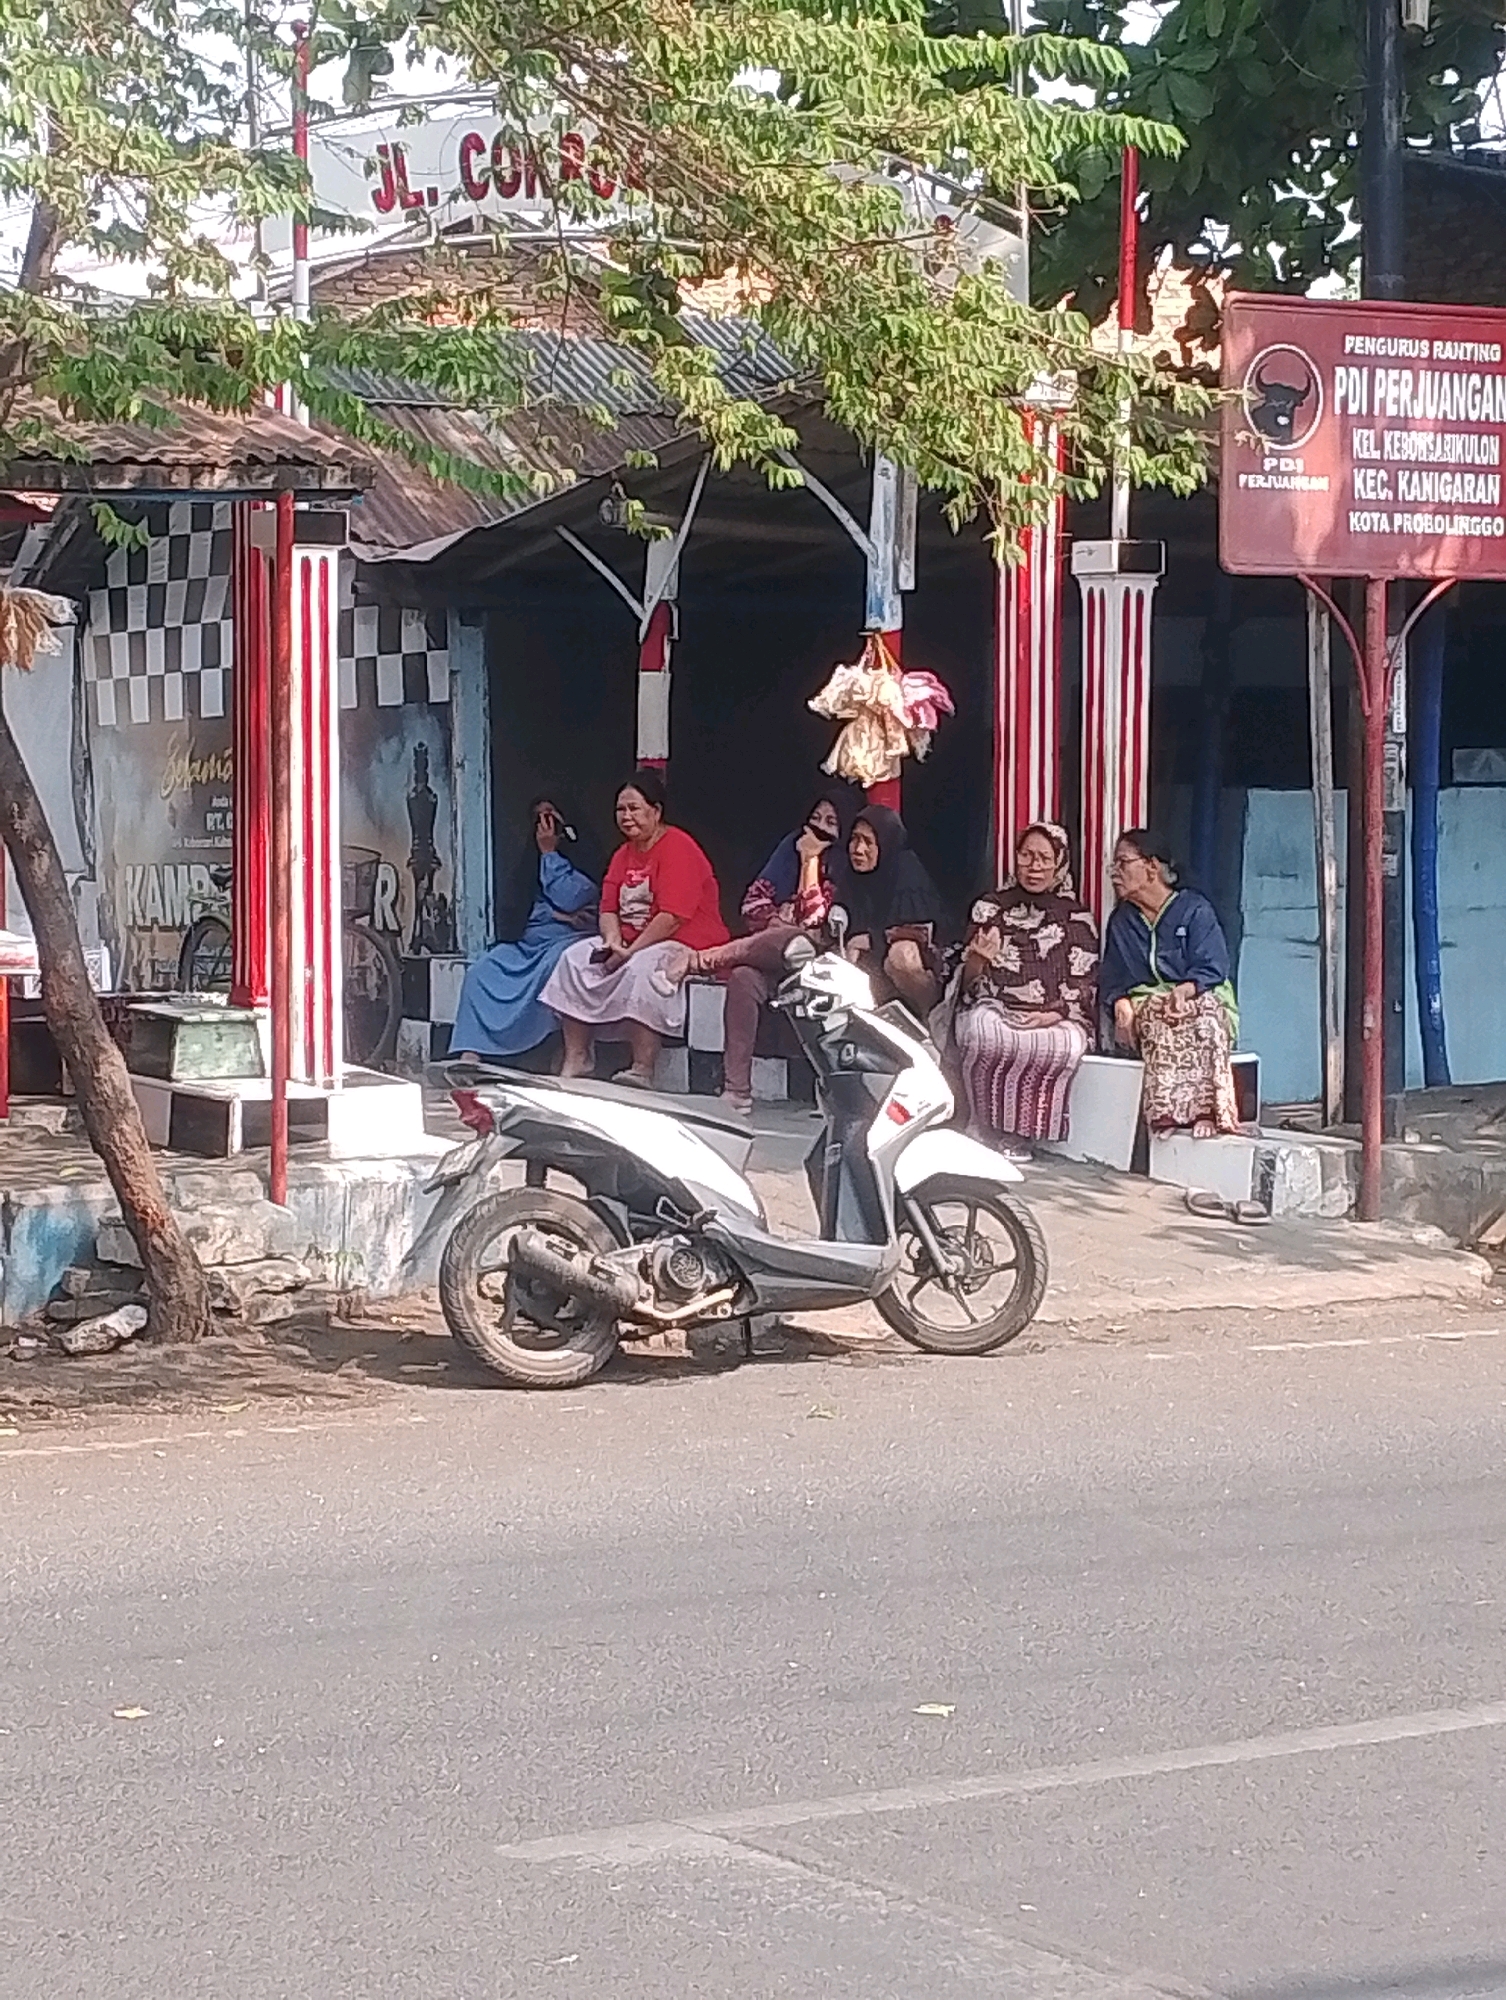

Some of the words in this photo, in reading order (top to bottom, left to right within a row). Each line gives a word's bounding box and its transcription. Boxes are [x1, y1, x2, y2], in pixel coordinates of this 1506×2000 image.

[371, 144, 438, 214] JL.
[1344, 334, 1430, 359] PENGURUS
[1433, 340, 1501, 363] RANTING
[1334, 366, 1368, 415] PDI
[1373, 368, 1506, 423] PERJUANGAN
[1352, 428, 1380, 459] KEL.
[1263, 457, 1304, 473] PDI
[1353, 468, 1393, 500] KEC.
[1397, 471, 1501, 505] KANIGARAN
[1349, 511, 1390, 532] KOTA
[1394, 513, 1505, 537] PROBOLINGGO
[125, 864, 232, 926] KAMP
